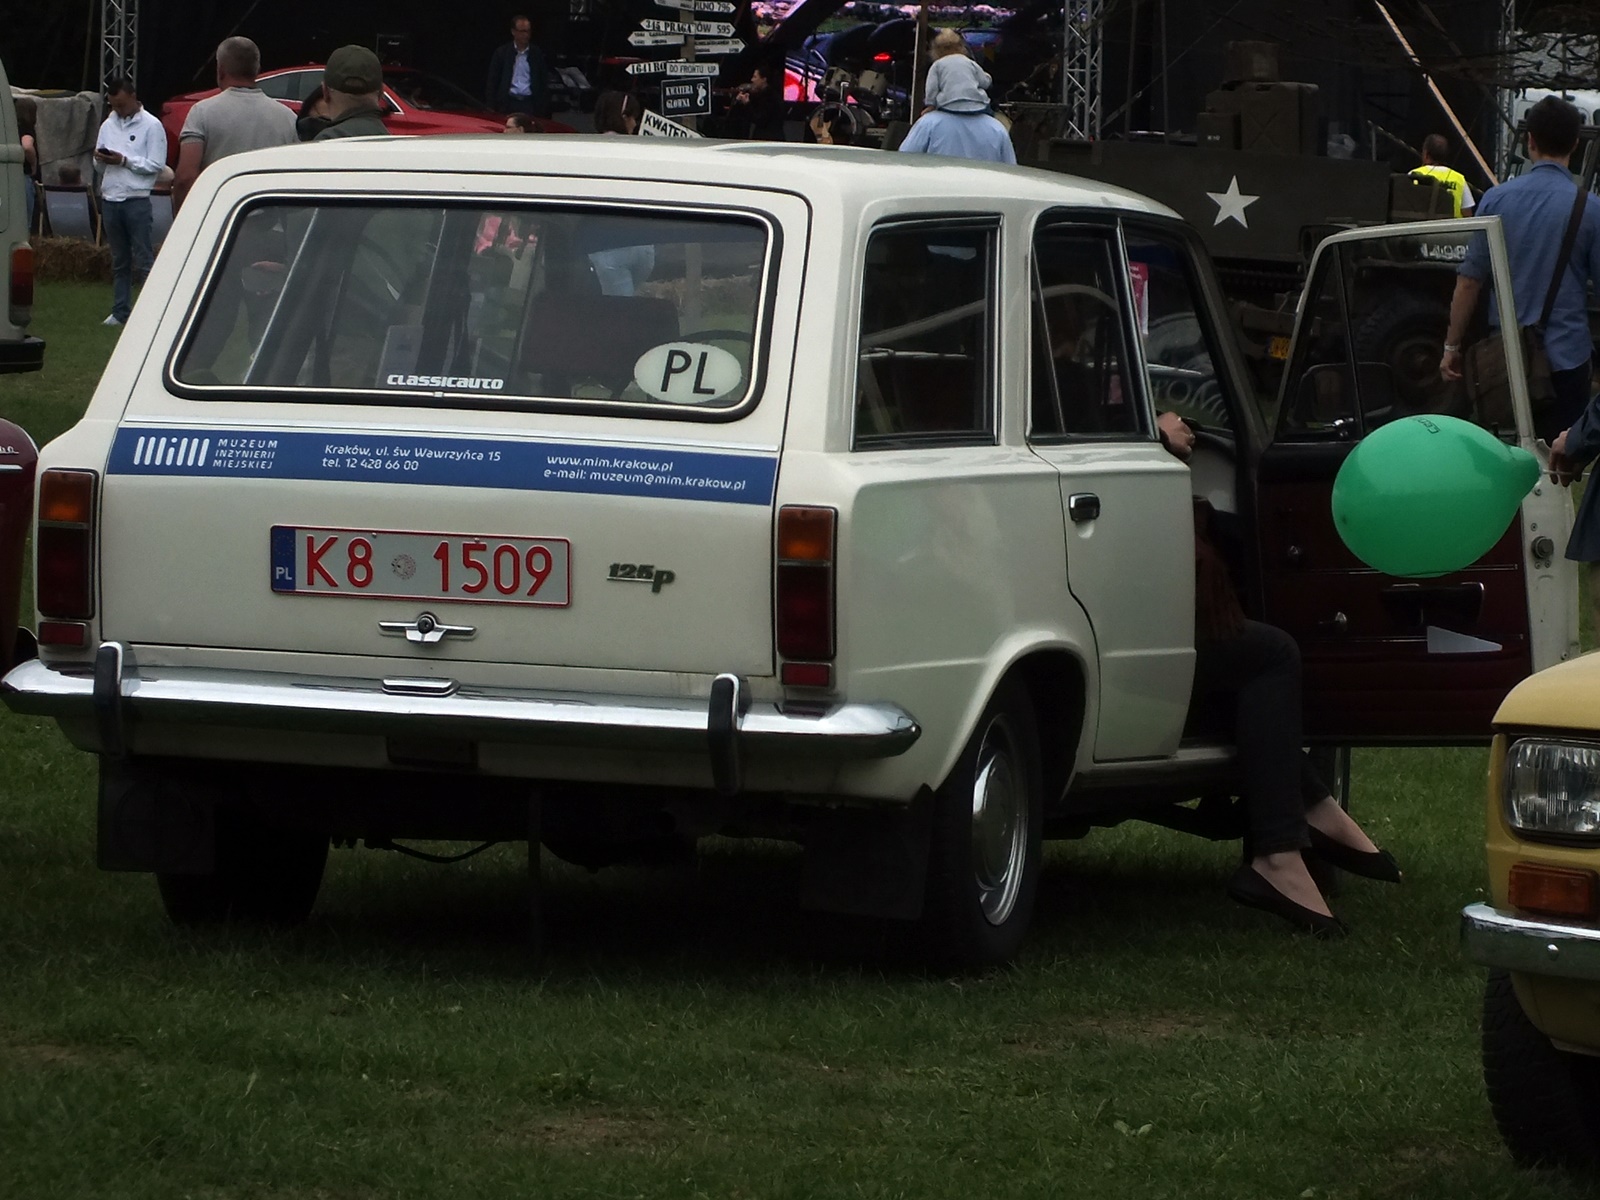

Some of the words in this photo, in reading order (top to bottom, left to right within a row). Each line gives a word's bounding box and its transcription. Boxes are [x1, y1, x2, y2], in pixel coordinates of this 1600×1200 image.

[664, 21, 691, 34] PRAGA
[695, 21, 711, 33] ÓW
[665, 84, 693, 96] KWATERA
[660, 349, 715, 395] PL
[218, 438, 278, 449] MUZEUM
[324, 444, 372, 457] Kraków,
[375, 445, 390, 457] ul.
[393, 446, 410, 457] św
[414, 447, 484, 462] Wawrzyńca
[488, 451, 501, 462] 15
[212, 459, 273, 469] MIEJSKIEJ
[322, 457, 341, 468] tel.
[345, 458, 357, 468] 12
[360, 459, 381, 469] 428
[385, 460, 400, 470] 66
[403, 460, 419, 471] 00
[546, 456, 674, 472] www.mim.krakow.pl
[543, 468, 587, 480] e-mail:
[589, 471, 746, 490] muzeum@mim.krakow.pl
[306, 535, 374, 588] K8
[432, 541, 553, 596] 1509
[275, 566, 293, 580] PL
[608, 562, 676, 594] 125p
